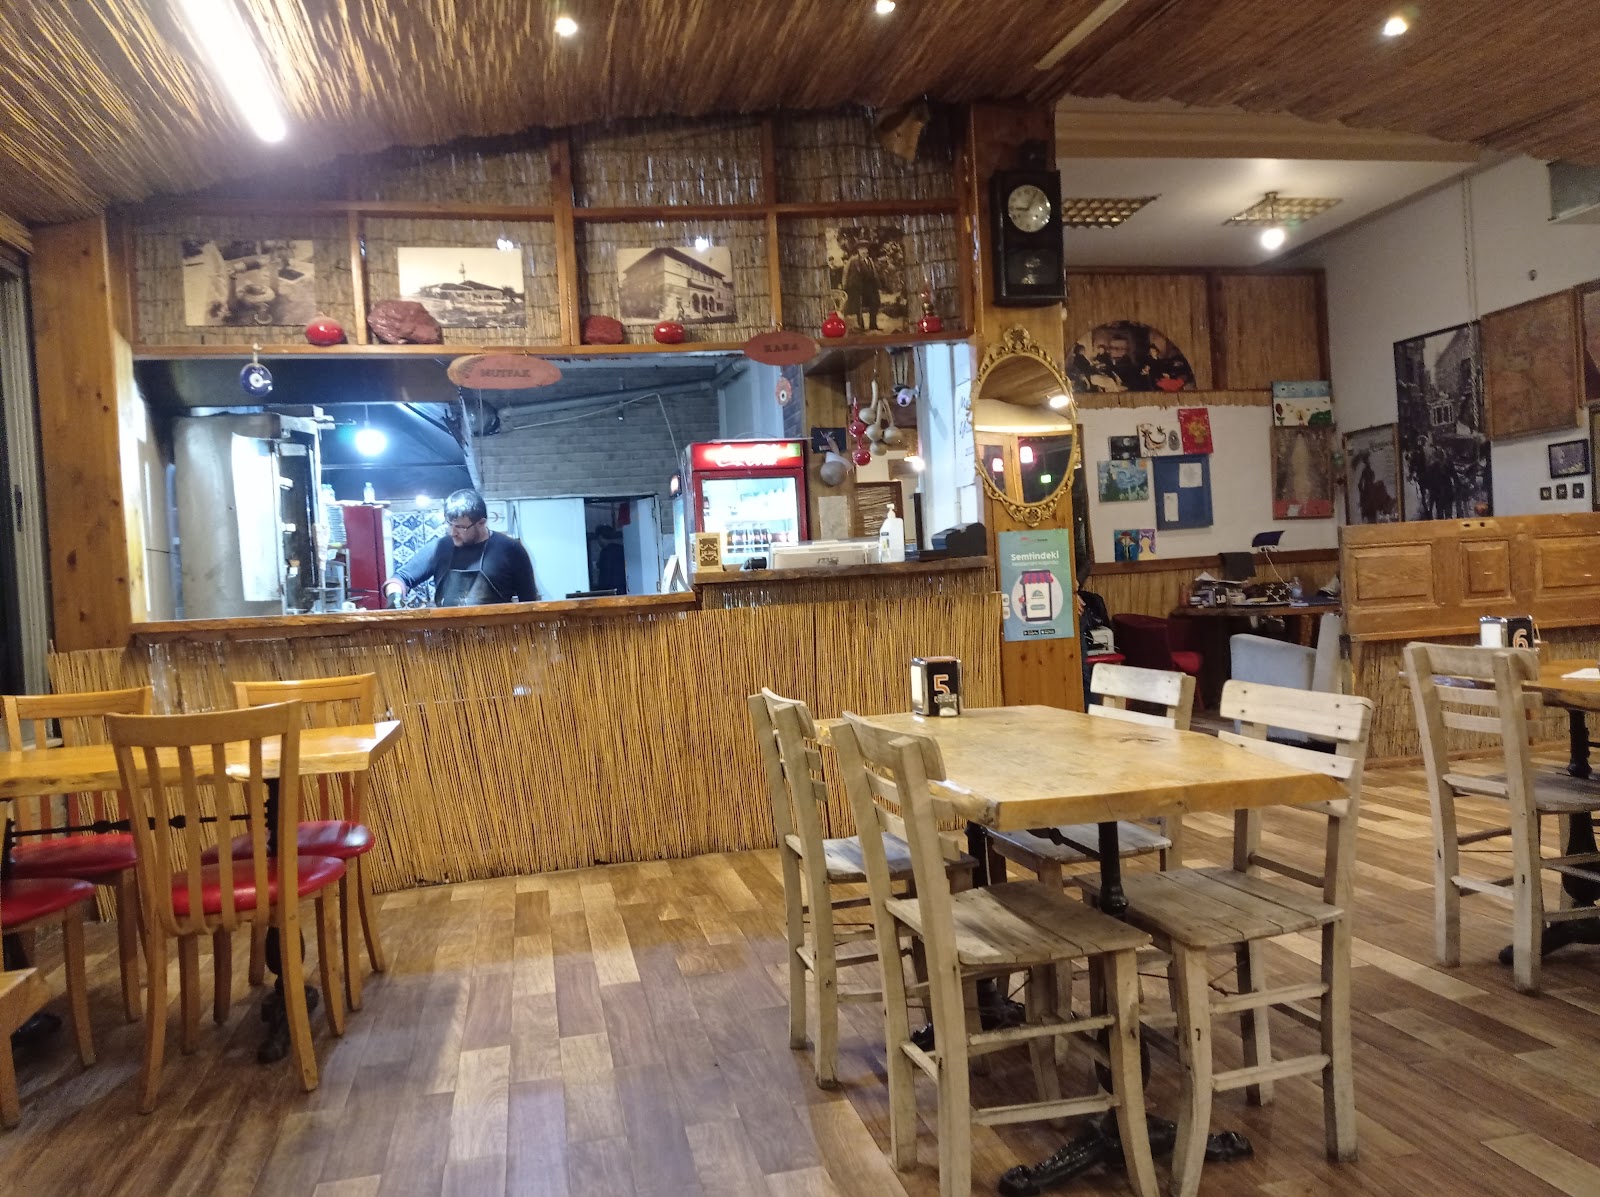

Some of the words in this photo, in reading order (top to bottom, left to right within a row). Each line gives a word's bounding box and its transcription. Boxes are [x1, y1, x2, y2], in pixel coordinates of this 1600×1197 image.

[480, 369, 530, 378] MUTFAK
[1010, 550, 1060, 561] Semtindeki
[1512, 628, 1529, 650] 6
[933, 674, 951, 704] 5
